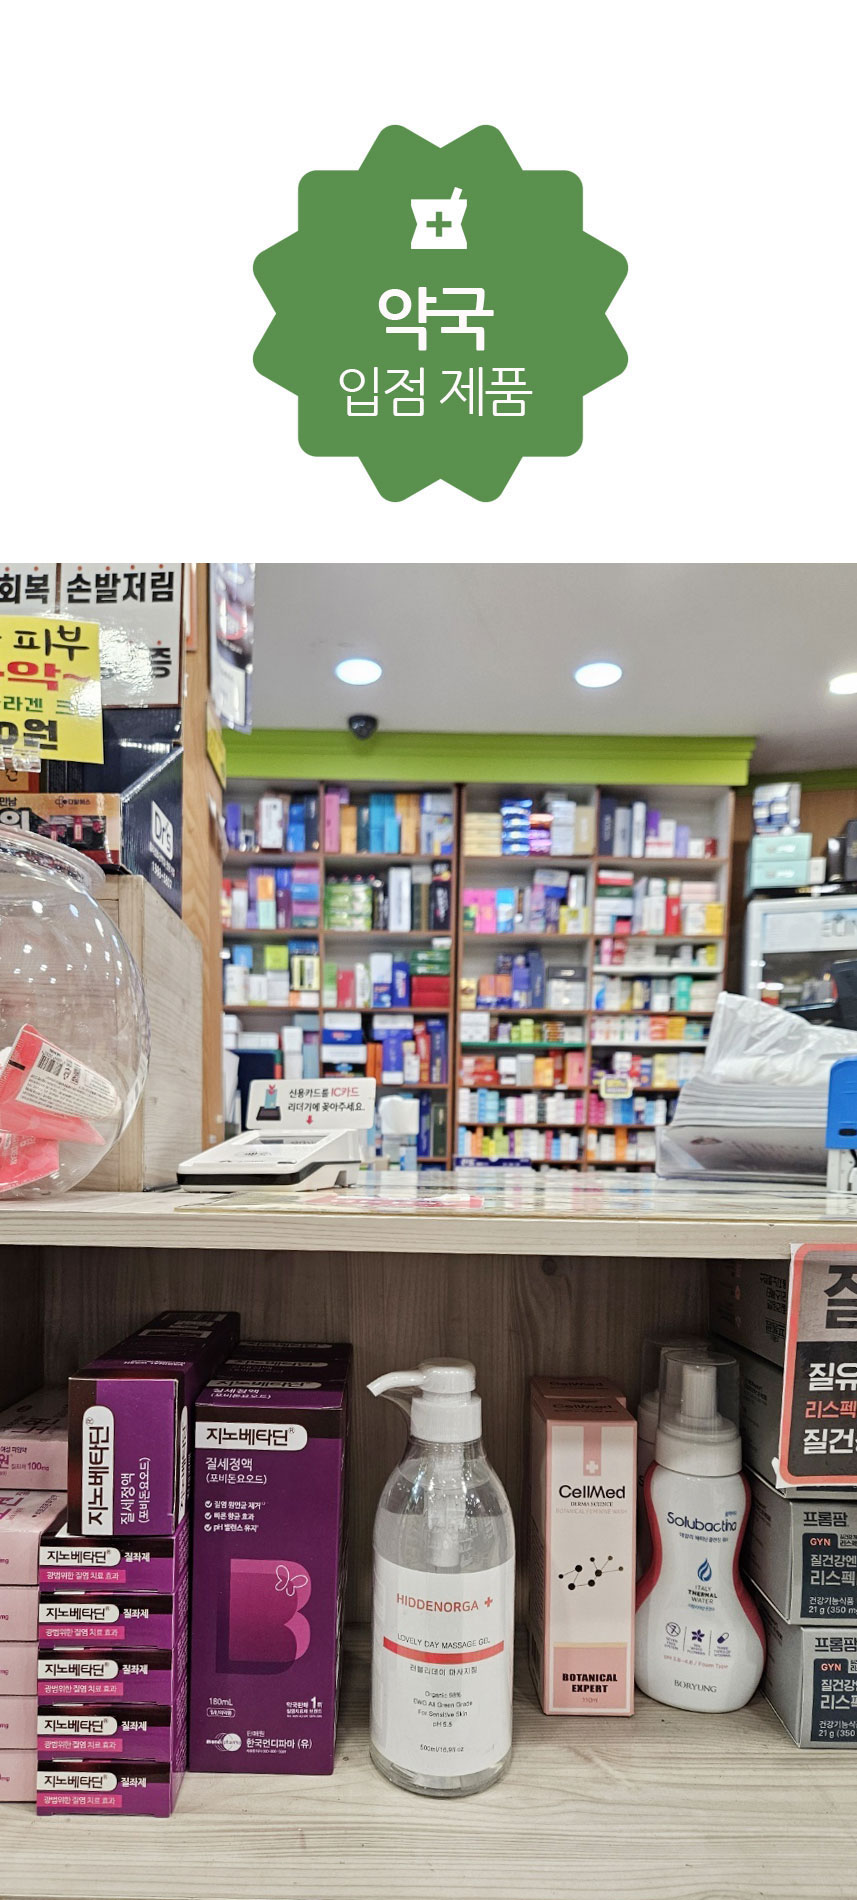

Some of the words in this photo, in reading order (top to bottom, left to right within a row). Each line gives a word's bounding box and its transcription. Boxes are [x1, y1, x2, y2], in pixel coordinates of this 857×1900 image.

[67, 572, 174, 604] 손발저림
[14, 625, 89, 661] 피부
[290, 1089, 328, 1098] 신용카드를
[331, 1087, 359, 1097] IC카드
[288, 1102, 319, 1112] 리더기에
[206, 1427, 288, 1446] 지노베타딘
[804, 1428, 857, 1455] 질건
[205, 1457, 252, 1471] 질세정액
[88, 1426, 109, 1524] 지노베타딘
[206, 1473, 267, 1485] (포비돈요오드)
[559, 1484, 625, 1499] CellMed
[120, 1472, 135, 1525] 질세정액
[803, 1512, 848, 1527] 프롬팜
[213, 1524, 223, 1532] pH
[810, 1538, 831, 1546] GYN
[47, 1550, 107, 1563] 지노베타딘
[106, 1572, 119, 1580] 효과
[688, 1590, 718, 1598] THERMAL
[396, 1593, 479, 1612] HIDDENORGA
[810, 1597, 854, 1605] 건강기능식품
[46, 1608, 105, 1620] 지노베타딘
[827, 1606, 846, 1614] (350
[105, 1629, 118, 1637] 효과
[398, 1633, 422, 1646] LOVELY
[442, 1640, 476, 1649] MASSAGE
[478, 1637, 490, 1645] GEL
[45, 1664, 104, 1676] 지노베타딘
[562, 1673, 618, 1682] BOTANICAL
[104, 1685, 117, 1693] 효과
[572, 1684, 608, 1693] EXPERT
[674, 1680, 717, 1692] BORYUNG
[821, 1680, 857, 1692] 질건강
[209, 1698, 233, 1706] 180mL
[44, 1720, 103, 1733] 지노베타딘
[819, 1721, 857, 1729] 건강기능식
[103, 1741, 116, 1749] 효과
[298, 1739, 312, 1749] (유)
[44, 1776, 103, 1788] 지노베타딘
[102, 1796, 116, 1804] 효과
